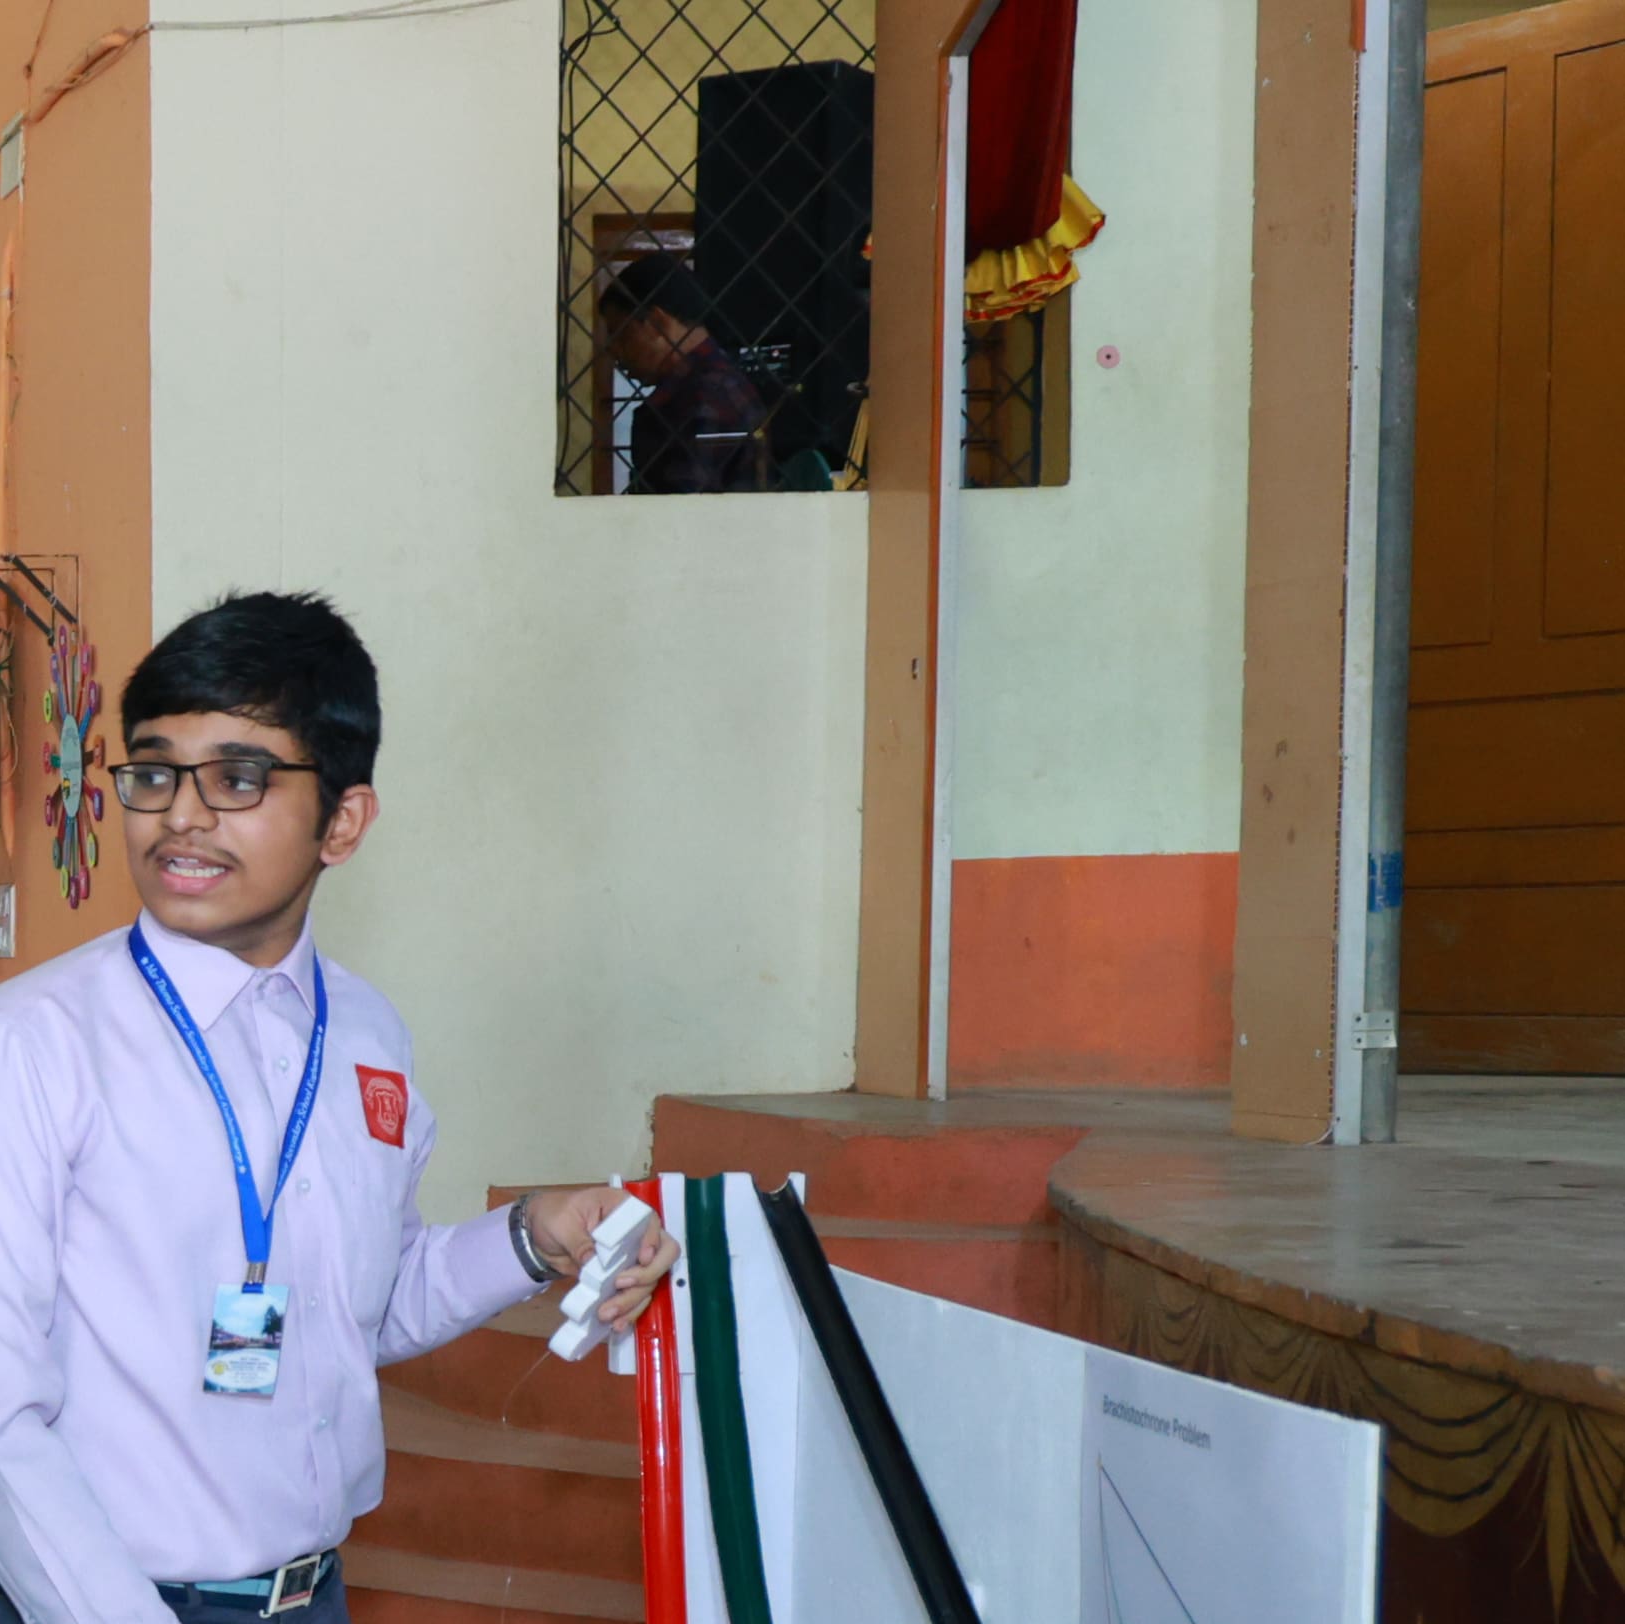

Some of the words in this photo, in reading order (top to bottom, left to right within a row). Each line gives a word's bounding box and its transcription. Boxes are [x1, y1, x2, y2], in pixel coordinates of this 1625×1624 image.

[187, 1029, 210, 1071] Secondary
[285, 1117, 305, 1161] Secondary
[296, 1088, 312, 1117] School
[1103, 1394, 1170, 1437] Brachistochrone
[1173, 1418, 1211, 1449] Problem
